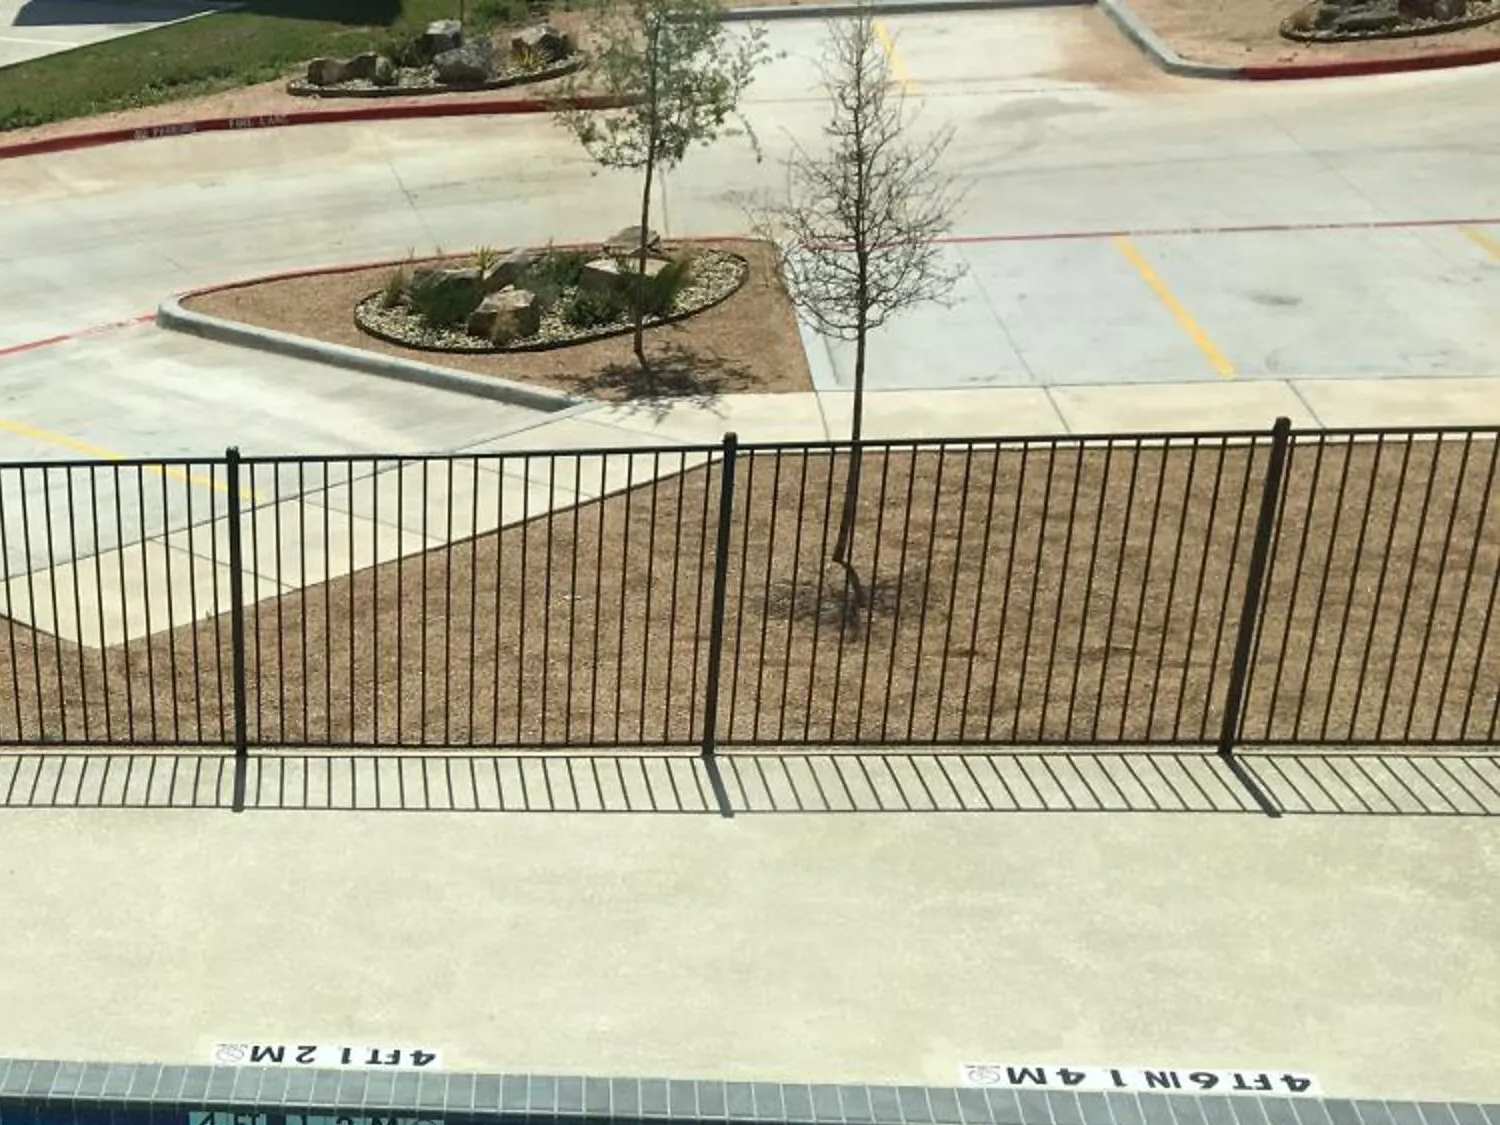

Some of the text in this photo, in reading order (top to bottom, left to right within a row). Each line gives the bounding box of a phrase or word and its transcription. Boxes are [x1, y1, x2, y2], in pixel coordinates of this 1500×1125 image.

[250, 1045, 285, 1063] M
[409, 1049, 436, 1066] 4
[1007, 1067, 1048, 1085] M
[1188, 1071, 1219, 1089] 6
[1280, 1073, 1311, 1092] 4
